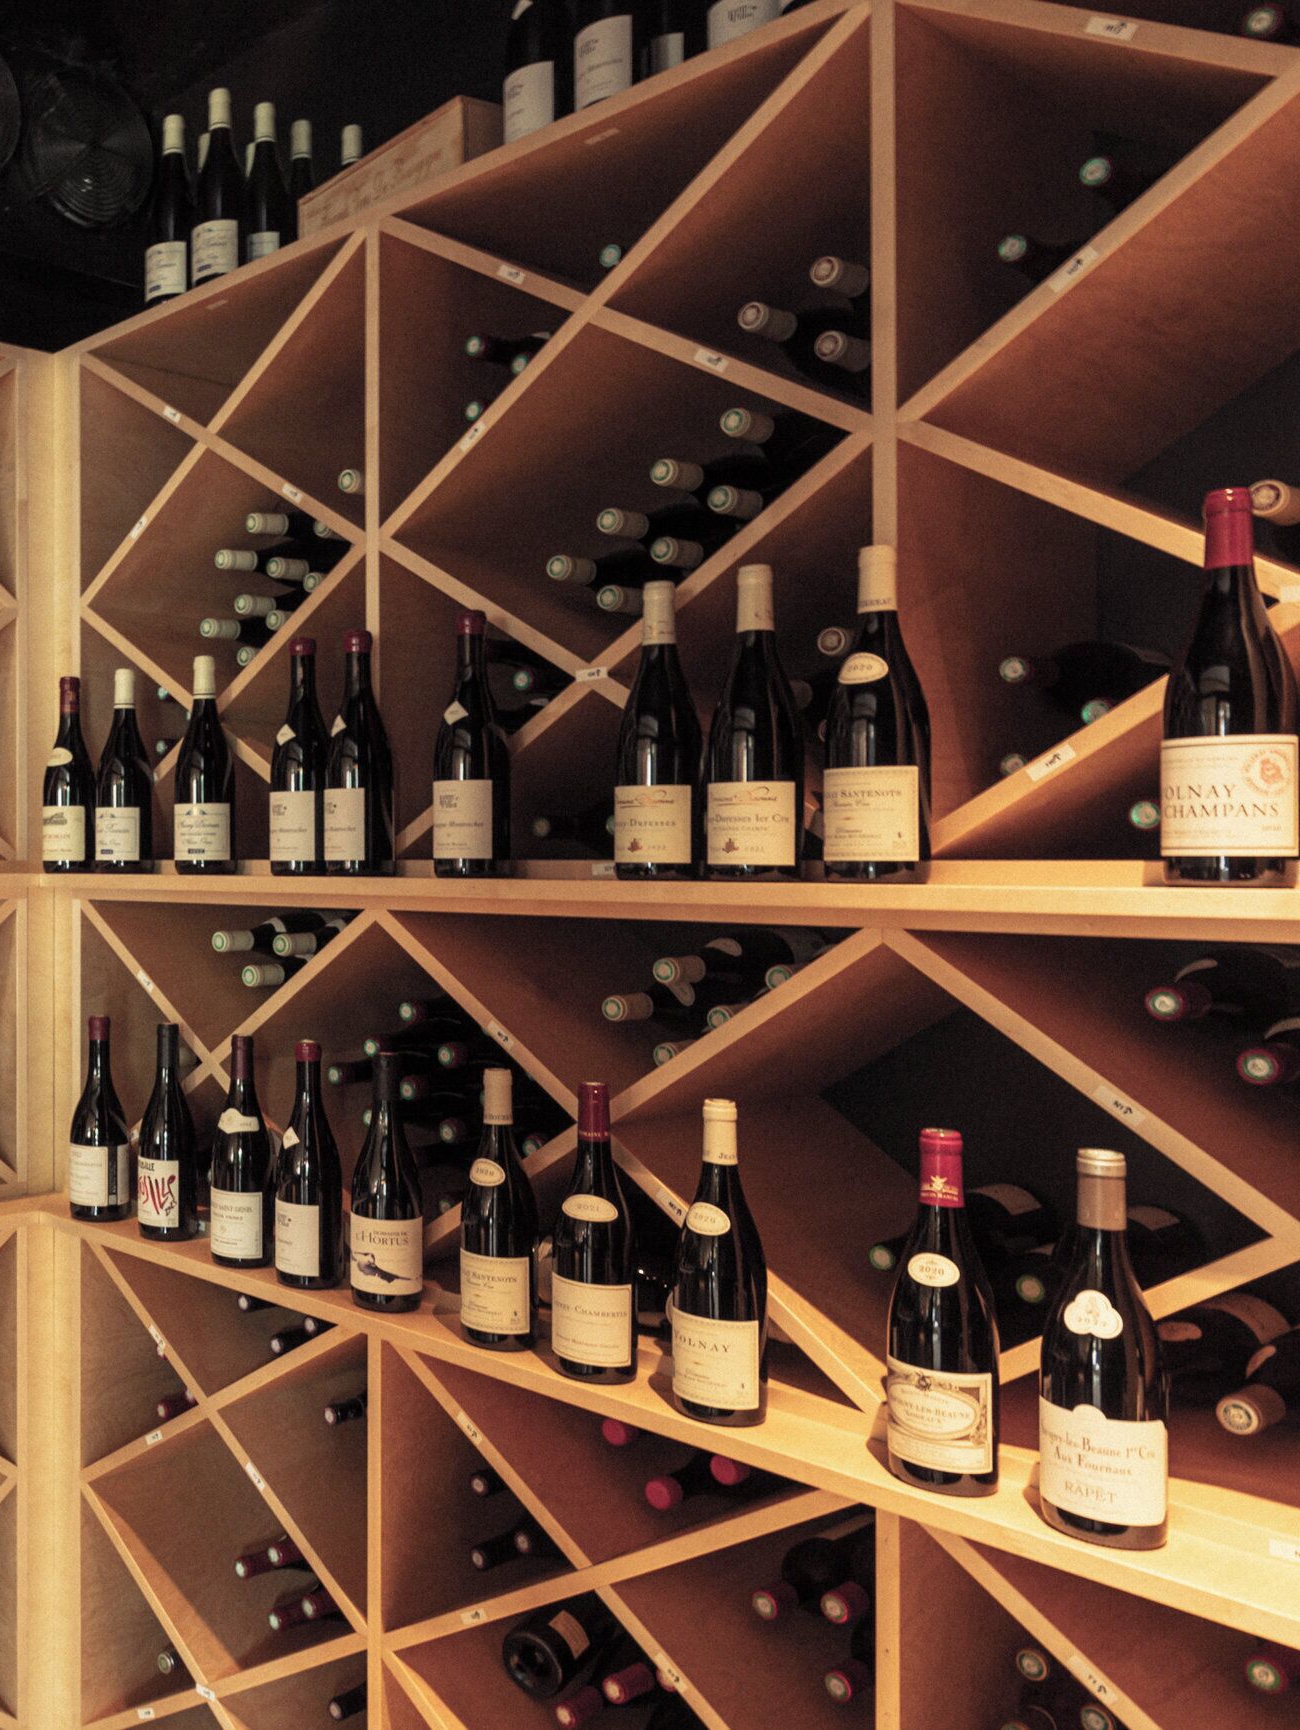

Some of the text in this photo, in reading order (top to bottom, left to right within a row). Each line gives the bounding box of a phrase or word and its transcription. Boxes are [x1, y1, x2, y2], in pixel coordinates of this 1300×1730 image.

[840, 788, 903, 800] SANTENOTS
[1164, 783, 1235, 801] OLNAY
[1164, 801, 1279, 819] CHAMPANS
[577, 1202, 601, 1213] 2021
[693, 1211, 717, 1224] 2020
[472, 1271, 518, 1284] SANTENOTS
[918, 1265, 946, 1277] 2020
[674, 1328, 731, 1353] VOLNAY
[1054, 1445, 1133, 1476] Aux Fournaux
[1063, 1480, 1117, 1504] RAPET
